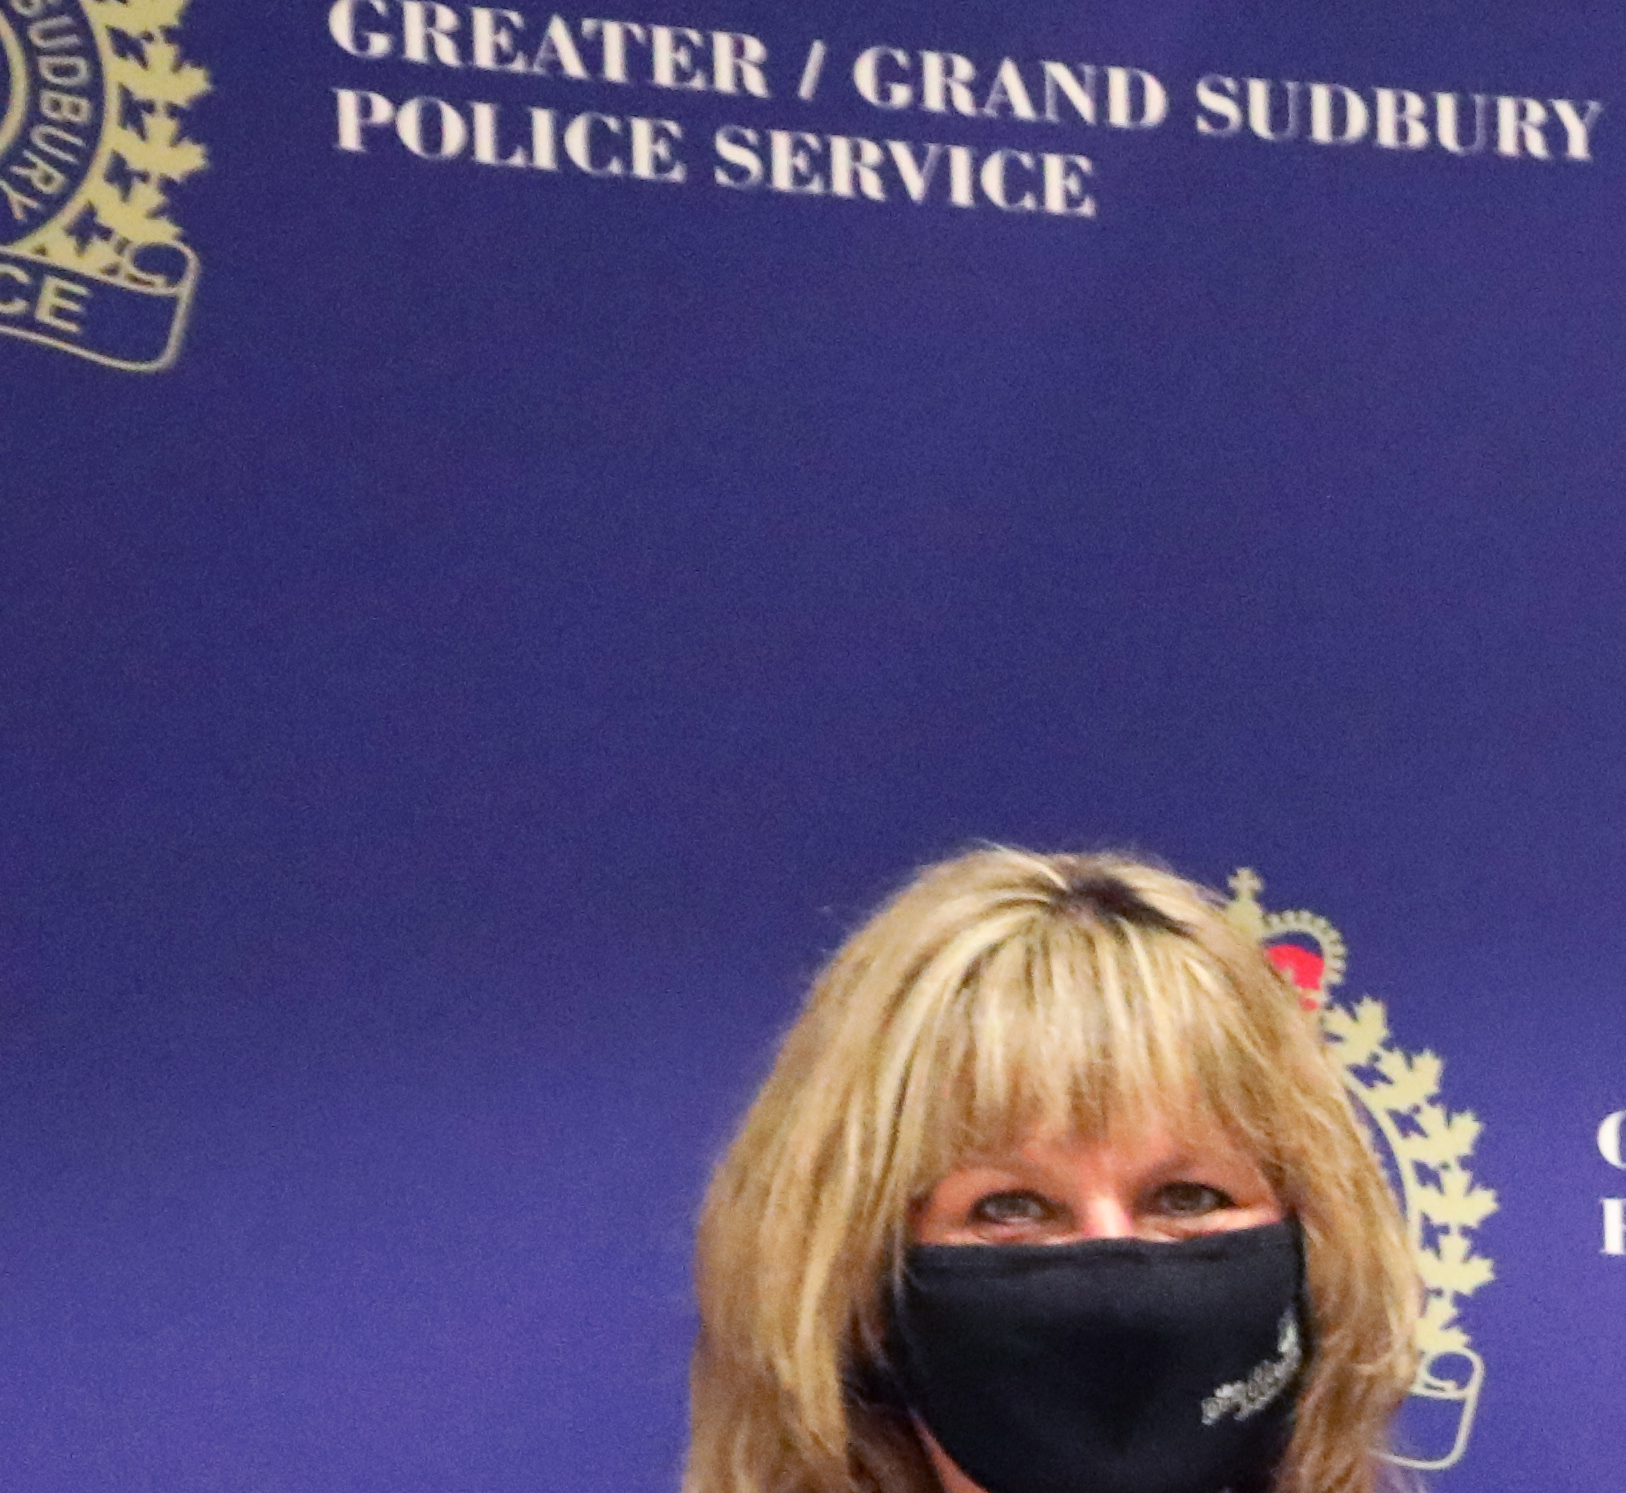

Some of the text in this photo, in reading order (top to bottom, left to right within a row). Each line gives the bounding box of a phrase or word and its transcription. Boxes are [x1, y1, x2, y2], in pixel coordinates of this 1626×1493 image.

[328, 0, 1601, 161] GREATER / GRAND SUDBURY
[335, 86, 1096, 216] POLICE SERVICE
